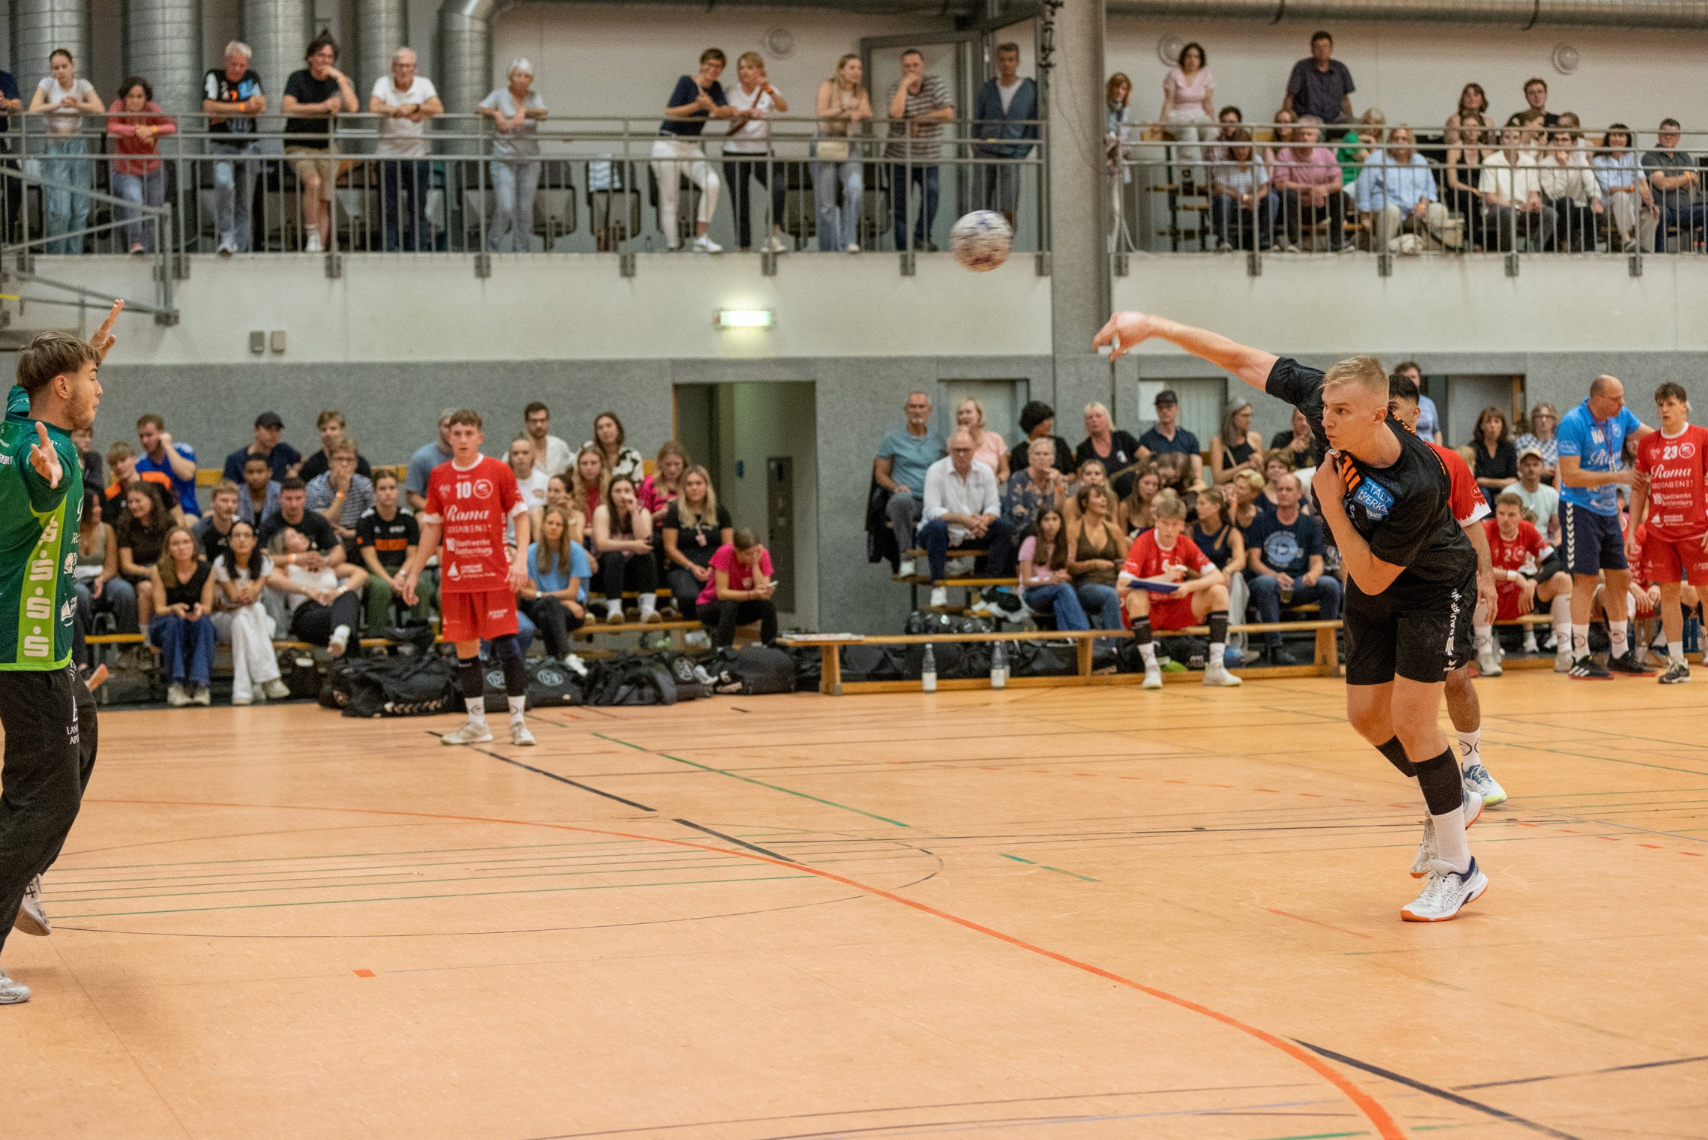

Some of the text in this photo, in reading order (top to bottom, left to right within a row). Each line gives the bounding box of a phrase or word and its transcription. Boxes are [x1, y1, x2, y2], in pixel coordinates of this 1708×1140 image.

[1662, 445, 1678, 460] 23
[1651, 464, 1691, 479] Roma
[455, 481, 472, 499] 10
[1364, 481, 1392, 503] STADT
[444, 504, 490, 522] Roma
